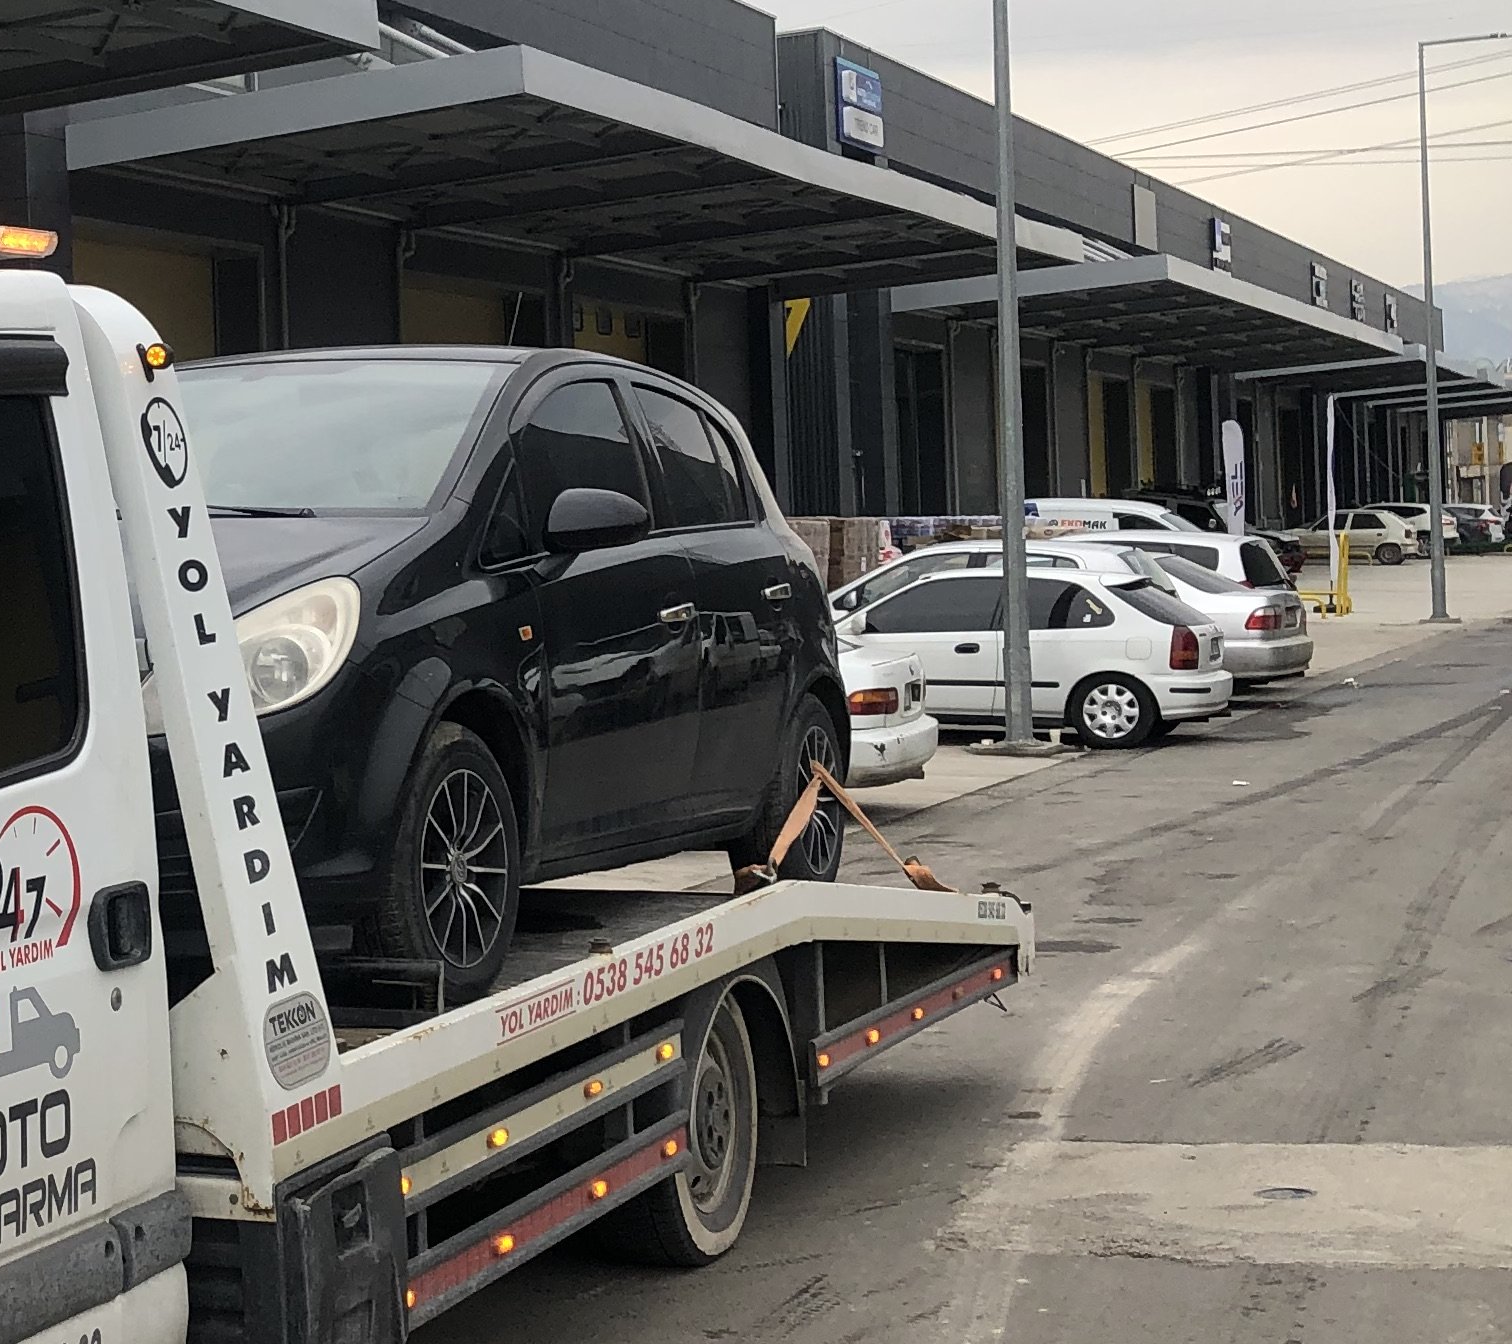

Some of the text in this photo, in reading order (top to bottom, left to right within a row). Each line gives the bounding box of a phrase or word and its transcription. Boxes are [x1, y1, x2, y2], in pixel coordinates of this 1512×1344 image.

[167, 506, 216, 645] YOL
[207, 687, 299, 993] YARDIM
[8, 938, 53, 970] YARDIM
[500, 1004, 524, 1036] YOL
[528, 988, 574, 1027] YARDIM
[583, 959, 627, 1007] 0538
[633, 942, 664, 986] 545
[669, 933, 690, 969] 68
[694, 922, 714, 957] 32
